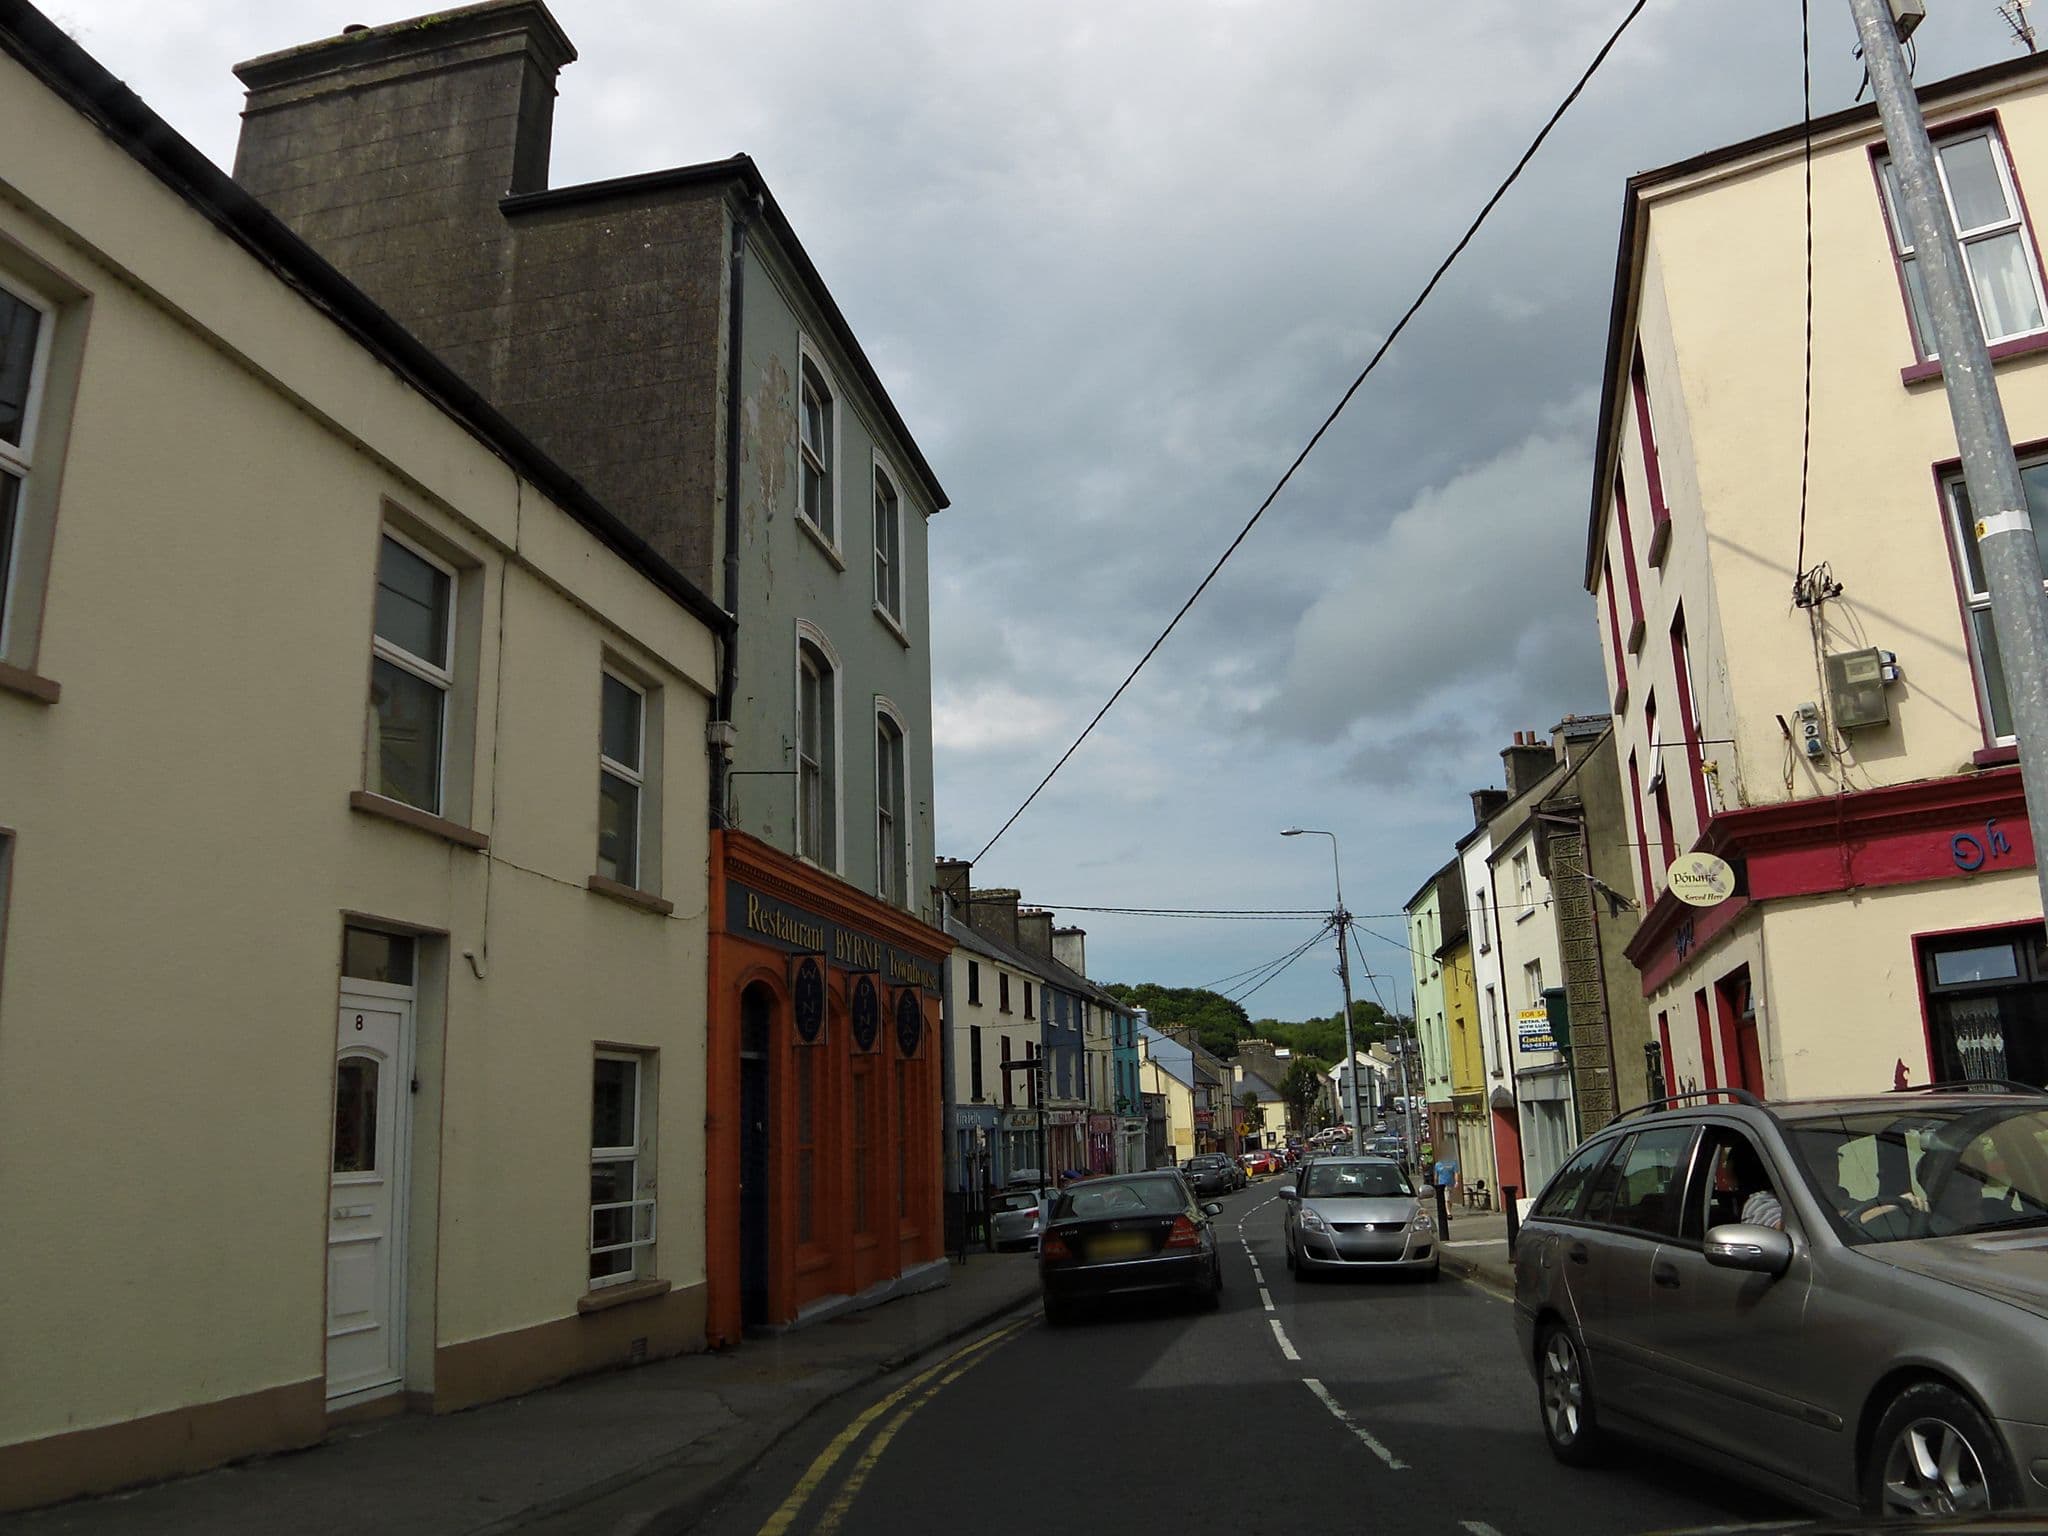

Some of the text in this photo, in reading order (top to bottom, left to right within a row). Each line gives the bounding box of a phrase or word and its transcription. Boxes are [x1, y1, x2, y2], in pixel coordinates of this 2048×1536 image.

[1685, 893, 1706, 901] Served
[747, 893, 824, 951] Restaurant
[888, 948, 936, 990] Townhouse
[801, 967, 817, 1033] WINE
[355, 1014, 364, 1031] 8
